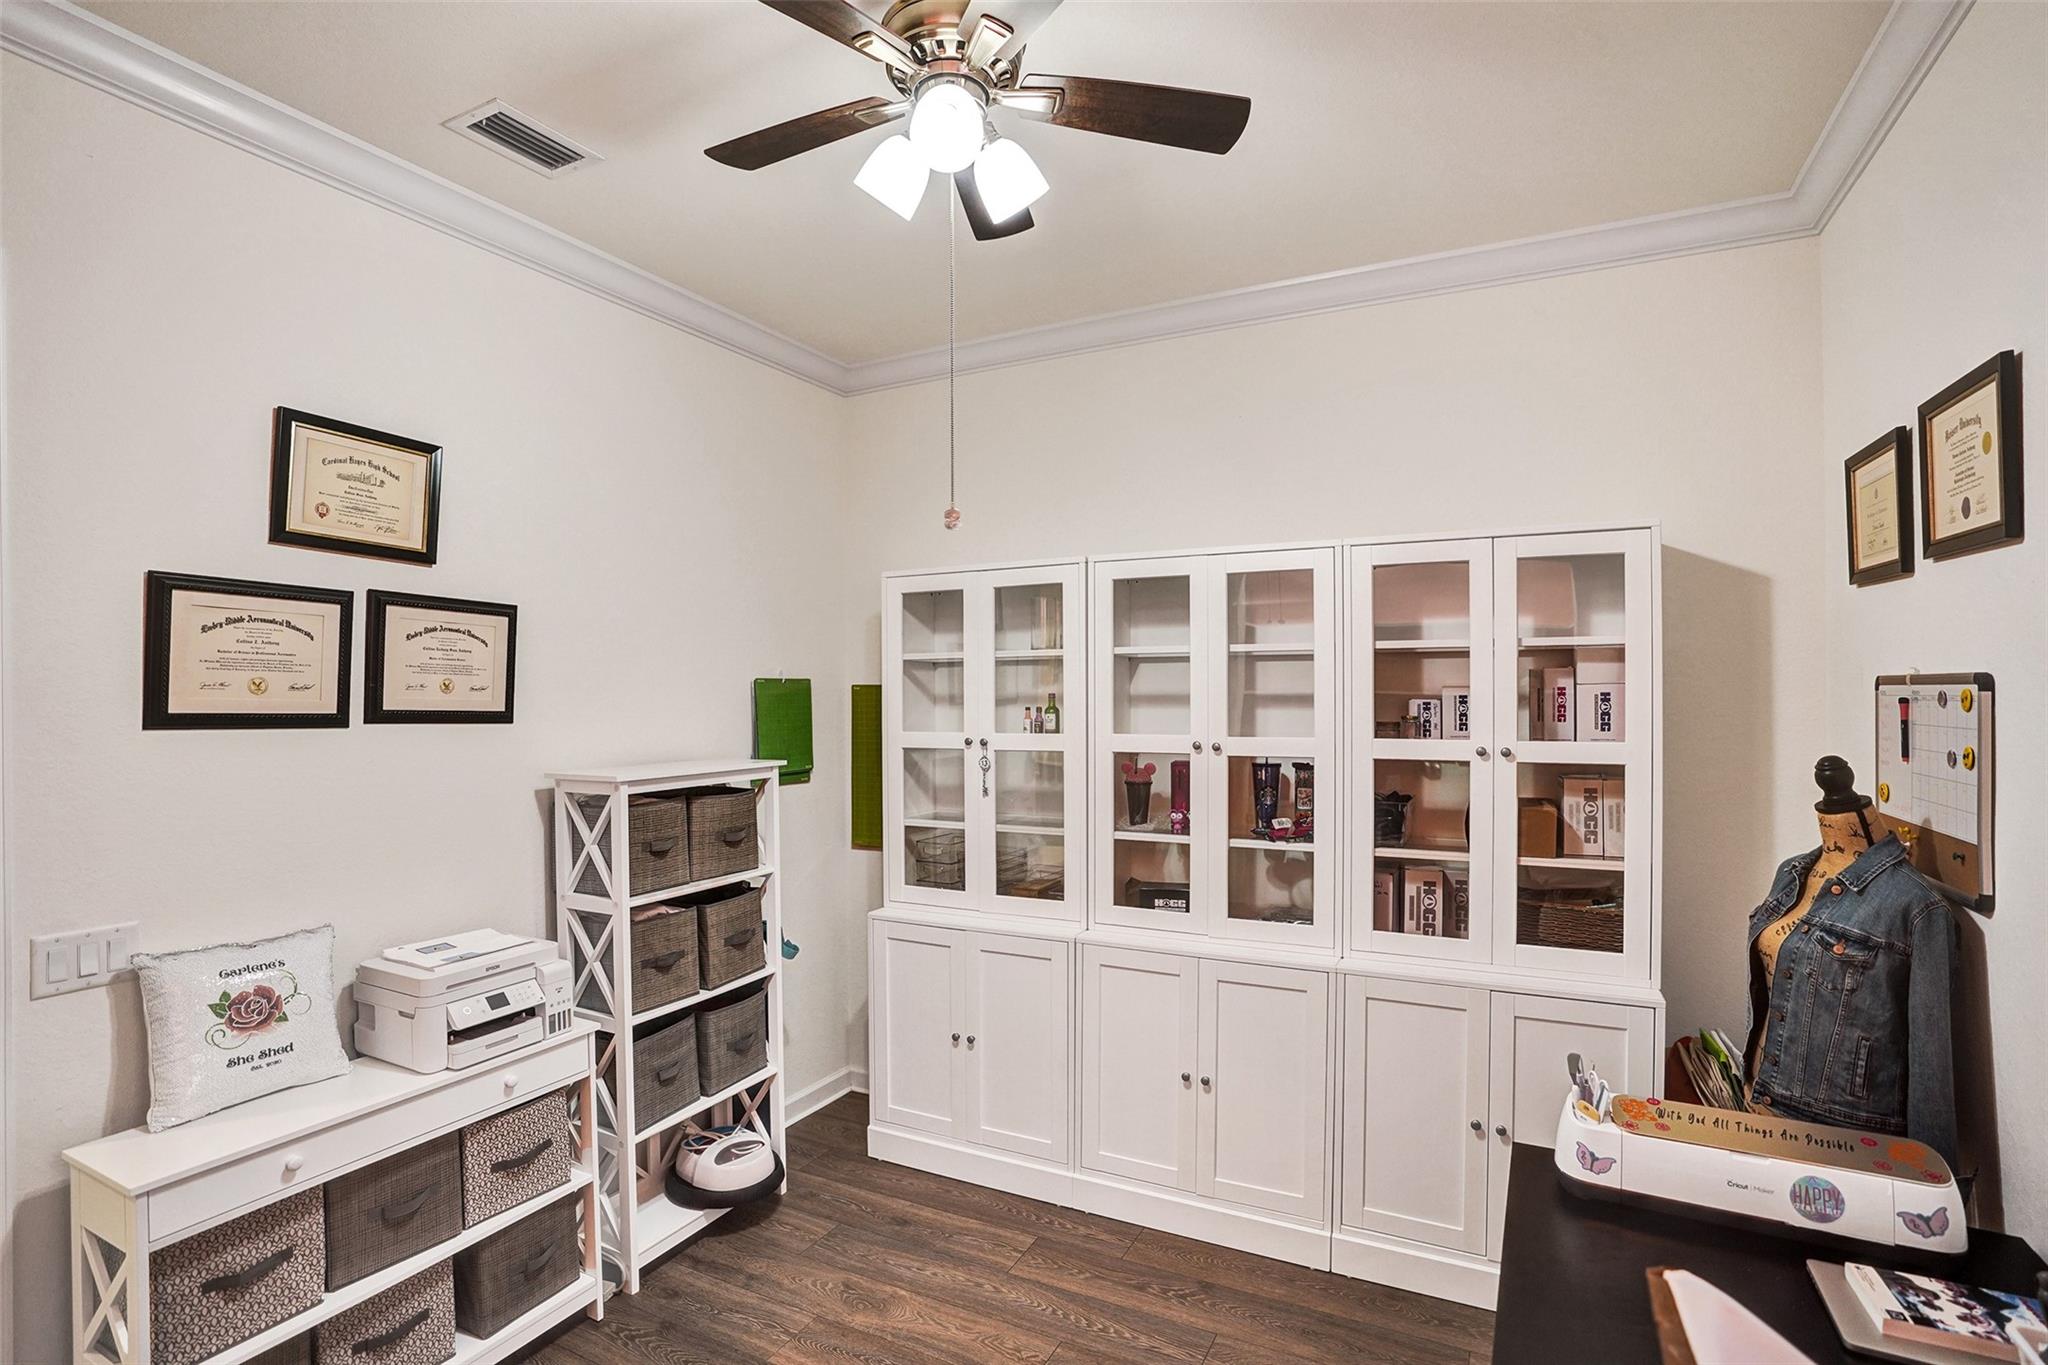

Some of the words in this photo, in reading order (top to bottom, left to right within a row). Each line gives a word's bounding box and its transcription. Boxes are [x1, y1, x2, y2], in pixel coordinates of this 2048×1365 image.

[321, 456, 348, 466] Cardinal
[368, 459, 381, 472] High
[382, 465, 400, 482] School
[246, 614, 285, 628] Aeronautical
[285, 619, 315, 642] University
[466, 629, 489, 648] University
[1458, 695, 1469, 731] HOGG
[1557, 687, 1567, 722] HOGG
[1600, 692, 1612, 732] HOGG
[1583, 788, 1599, 844] HOGG
[1154, 898, 1186, 908] HOGG
[485, 964, 501, 972] EPSON
[226, 1054, 255, 1068] She
[258, 1042, 294, 1060] Shed
[1655, 1107, 1682, 1120] With
[1713, 1117, 1729, 1130] All
[1735, 1121, 1773, 1138] Things
[1780, 1129, 1799, 1141] Are
[1805, 1133, 1855, 1152] Possible
[1726, 1180, 1749, 1190] Cricut
[1792, 1183, 1841, 1216] HAPPY
